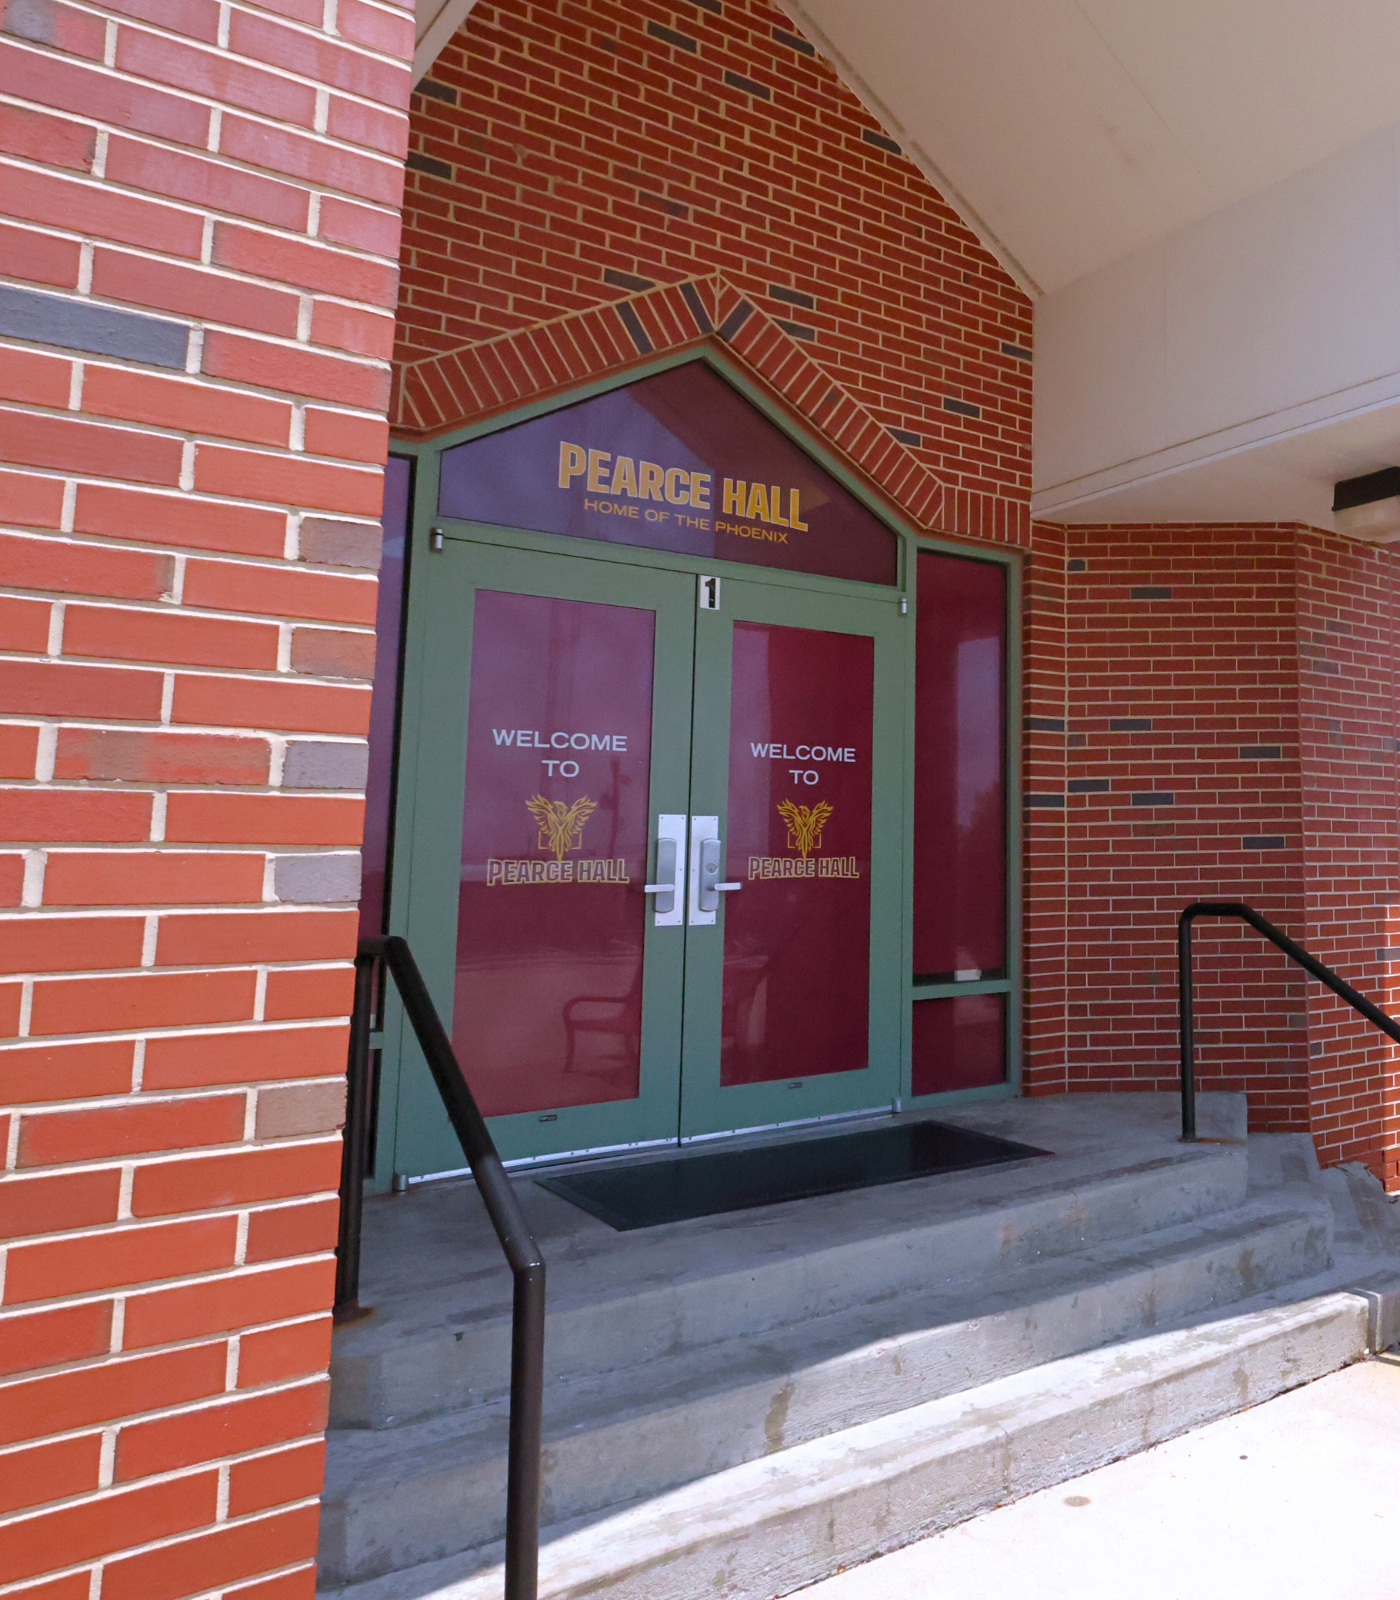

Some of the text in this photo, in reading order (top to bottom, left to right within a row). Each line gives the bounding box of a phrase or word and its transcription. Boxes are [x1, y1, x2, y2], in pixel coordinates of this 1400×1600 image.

[558, 441, 809, 532] PEARCE HALL
[584, 498, 789, 544] HOME OF THE PHOENIX
[705, 578, 716, 608] 1
[492, 728, 628, 752] WELCOME
[750, 742, 856, 763] WELCOME
[541, 760, 580, 778] TO
[788, 769, 819, 786] TO
[486, 858, 630, 887] PEARCE HALL
[748, 856, 860, 881] PEARCE HALL
